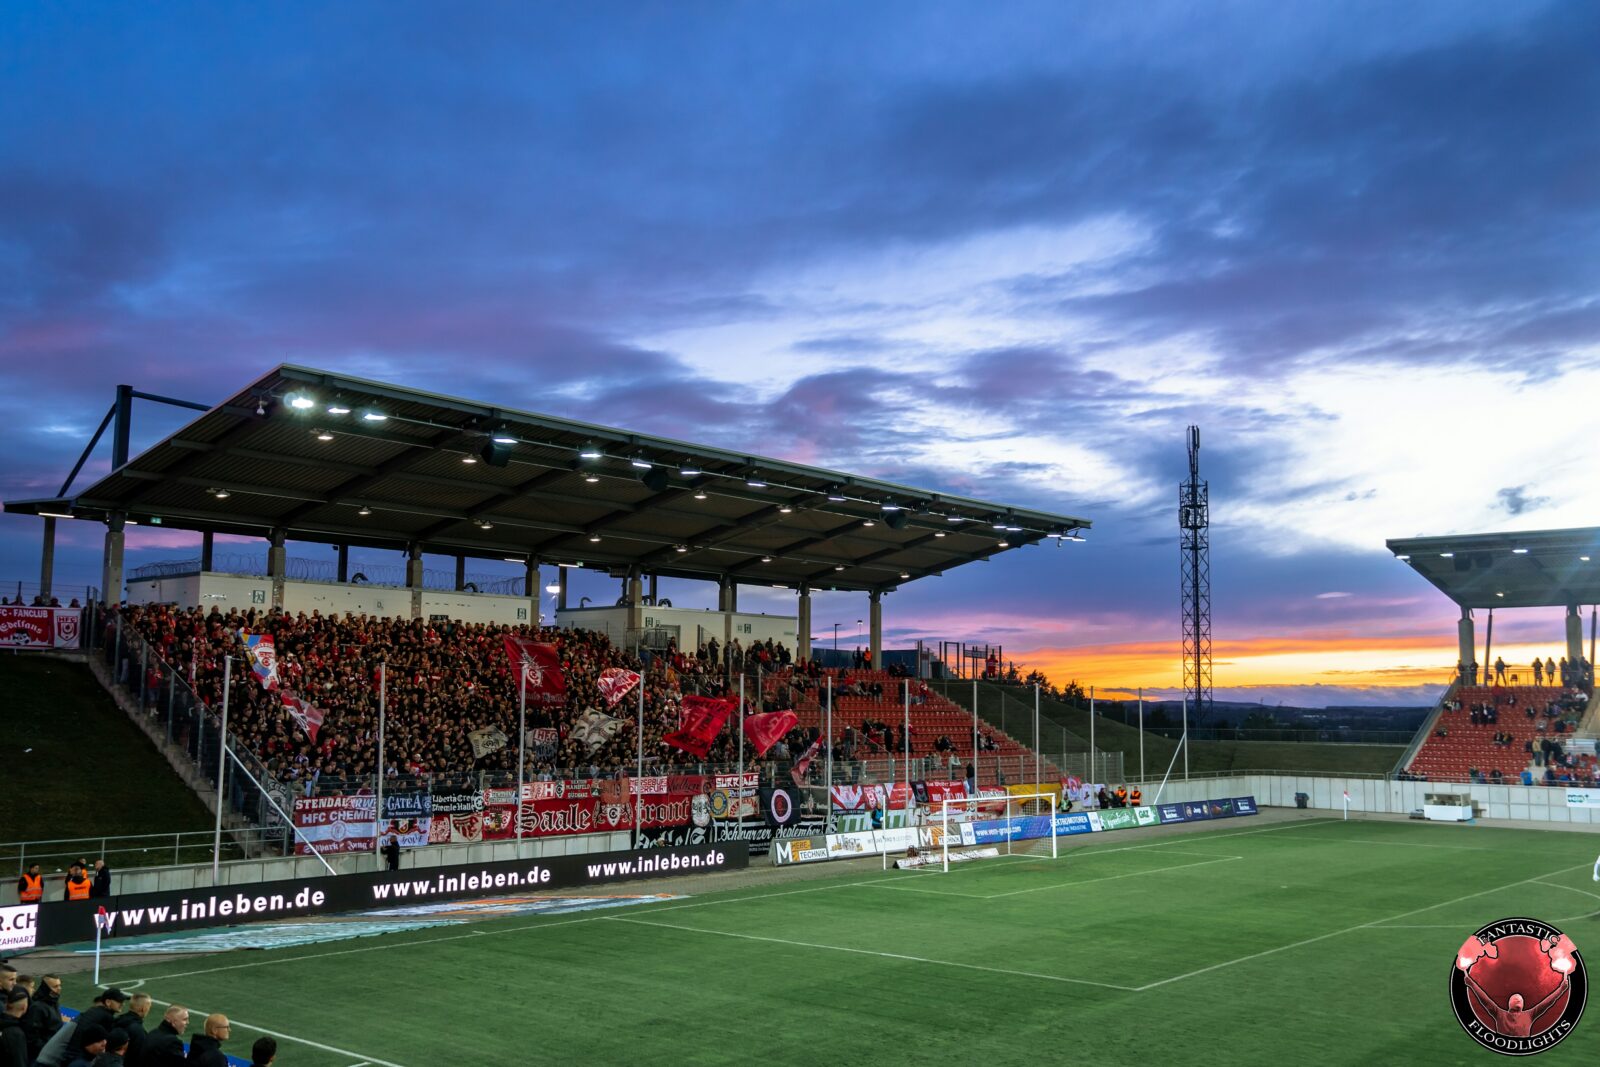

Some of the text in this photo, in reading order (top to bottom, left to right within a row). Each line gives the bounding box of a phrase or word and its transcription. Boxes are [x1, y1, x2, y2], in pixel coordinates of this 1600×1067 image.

[13, 608, 48, 618] FANCLUB
[296, 797, 348, 810] STENDAL
[302, 808, 377, 824] HFC CHEMIE
[514, 803, 591, 832] Saale
[587, 849, 725, 878] www.inleben.de
[799, 851, 826, 861] TECHNIK
[372, 865, 551, 899] www.inleben.de
[94, 887, 325, 929] www.inleben.de
